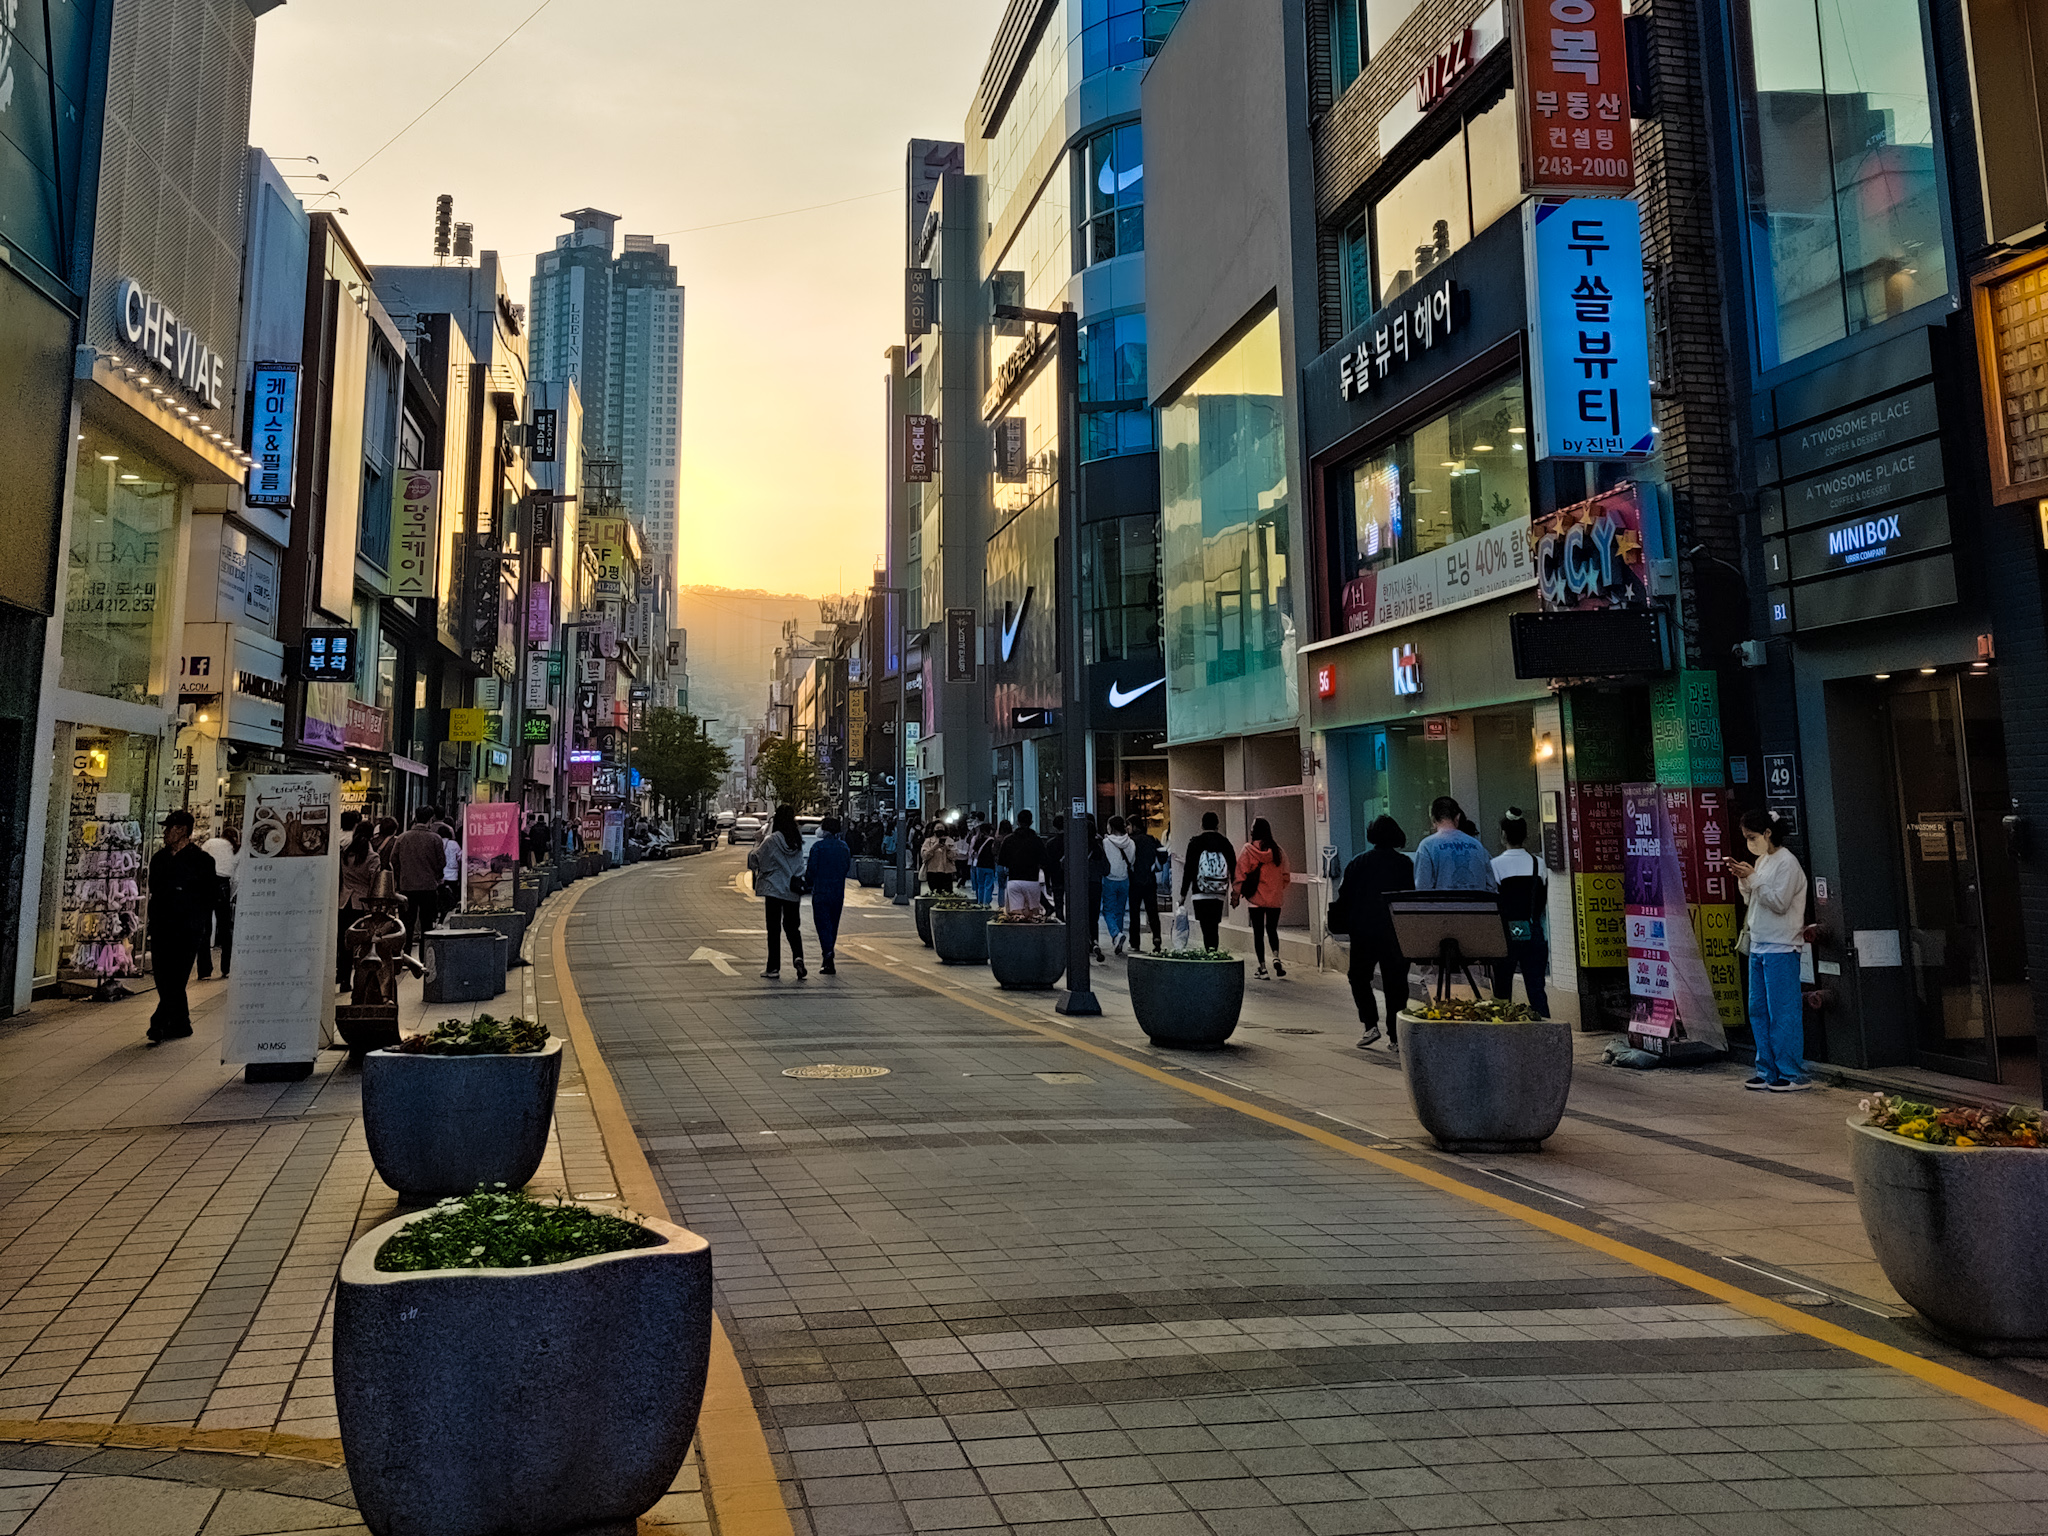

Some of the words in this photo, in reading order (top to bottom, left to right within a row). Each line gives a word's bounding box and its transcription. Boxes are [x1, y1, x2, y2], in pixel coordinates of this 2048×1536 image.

[1416, 29, 1468, 112] MIZZ
[1536, 91, 1621, 120] 부동산
[1549, 128, 1613, 150] 컨설팅
[1538, 156, 1628, 178] 243-2000
[569, 303, 581, 357] LEEIN
[1340, 341, 1370, 402] 두쏠
[1375, 310, 1409, 379] 뷰티
[1414, 279, 1451, 349] 헤어
[1567, 220, 1618, 436] 두쏠뷰티
[126, 280, 224, 410] CHEVIAE
[260, 378, 286, 490] 케이스&필름
[1810, 416, 1868, 445] TWOSOME
[1871, 401, 1911, 426] PLACE
[1563, 438, 1583, 453] by
[1585, 437, 1624, 453] 진빈
[1814, 470, 1873, 497] TWOSOME
[1876, 456, 1916, 479] PLACE
[399, 504, 430, 592] 망고케이스
[1447, 549, 1470, 587] 모닝
[1475, 537, 1508, 578] 40%
[1537, 512, 1616, 602] CCY
[1772, 554, 1779, 571] 1
[1350, 582, 1369, 609] 1+1
[1418, 591, 1434, 612] 무료
[1773, 603, 1787, 621] B1
[311, 637, 348, 653] 필름
[309, 655, 347, 671] 부착
[1392, 643, 1419, 695] kt
[1319, 671, 1329, 692] 5G
[1771, 767, 1790, 786] 49
[469, 821, 509, 836] 야놀자
[1700, 792, 1726, 900] 두쏠뷰티
[1706, 912, 1731, 929] CCY
[1711, 965, 1735, 985] 연습장
